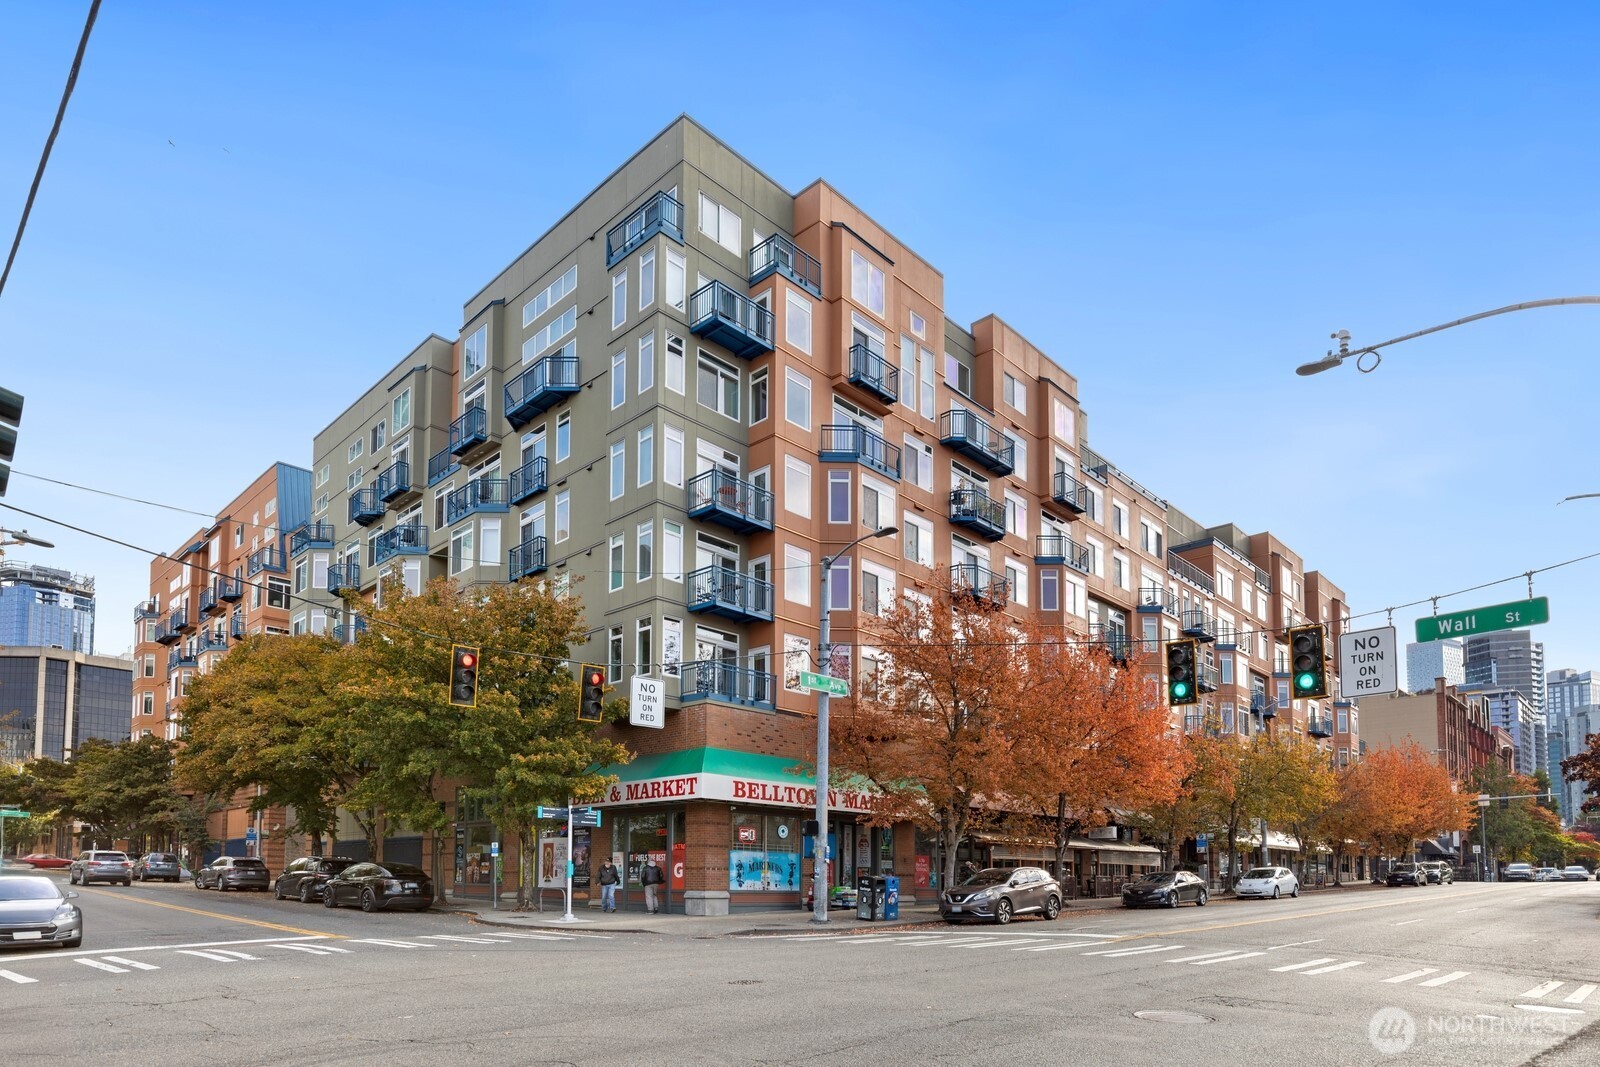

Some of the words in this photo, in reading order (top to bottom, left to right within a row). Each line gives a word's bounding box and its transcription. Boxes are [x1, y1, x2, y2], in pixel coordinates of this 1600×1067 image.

[1437, 615, 1476, 635] Wall
[1505, 611, 1521, 623] St
[1354, 635, 1381, 651] NO
[1351, 650, 1384, 665] TURN
[1359, 665, 1377, 677] ON
[641, 683, 656, 694] NO
[829, 681, 842, 691] Ave
[1356, 677, 1381, 690] RED
[638, 694, 657, 703] TURN
[642, 704, 652, 712] ON
[640, 713, 655, 722] RED
[610, 785, 621, 802] &
[626, 777, 698, 801] MARKET
[733, 780, 838, 807] BELLTON
[656, 853, 666, 862] BEST
[673, 862, 684, 878] G
